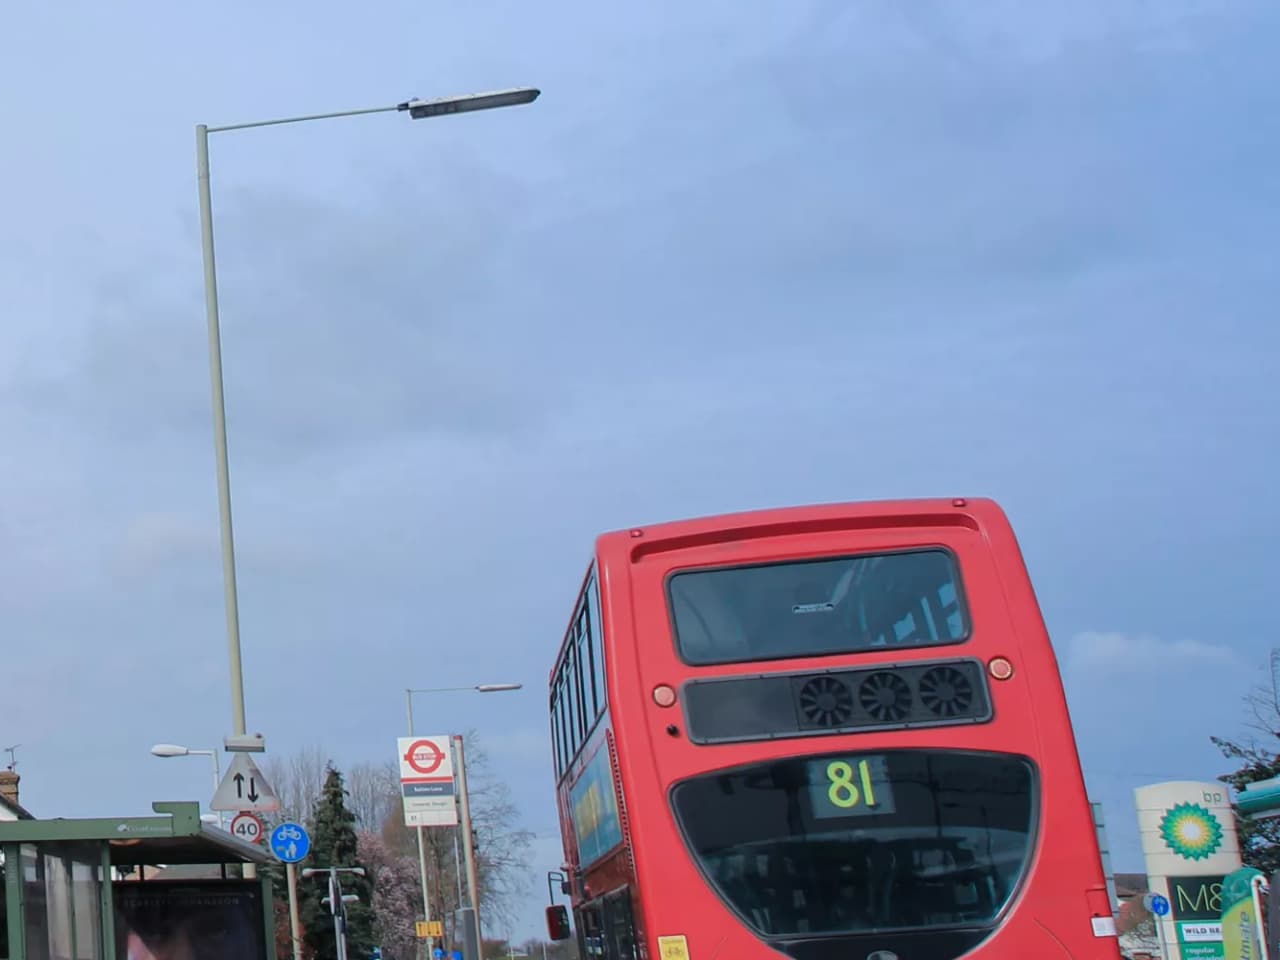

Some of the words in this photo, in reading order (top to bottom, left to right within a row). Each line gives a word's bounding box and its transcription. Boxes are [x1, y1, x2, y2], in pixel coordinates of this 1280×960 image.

[827, 760, 874, 808] 81
[1203, 791, 1223, 804] bp
[236, 823, 258, 836] 40
